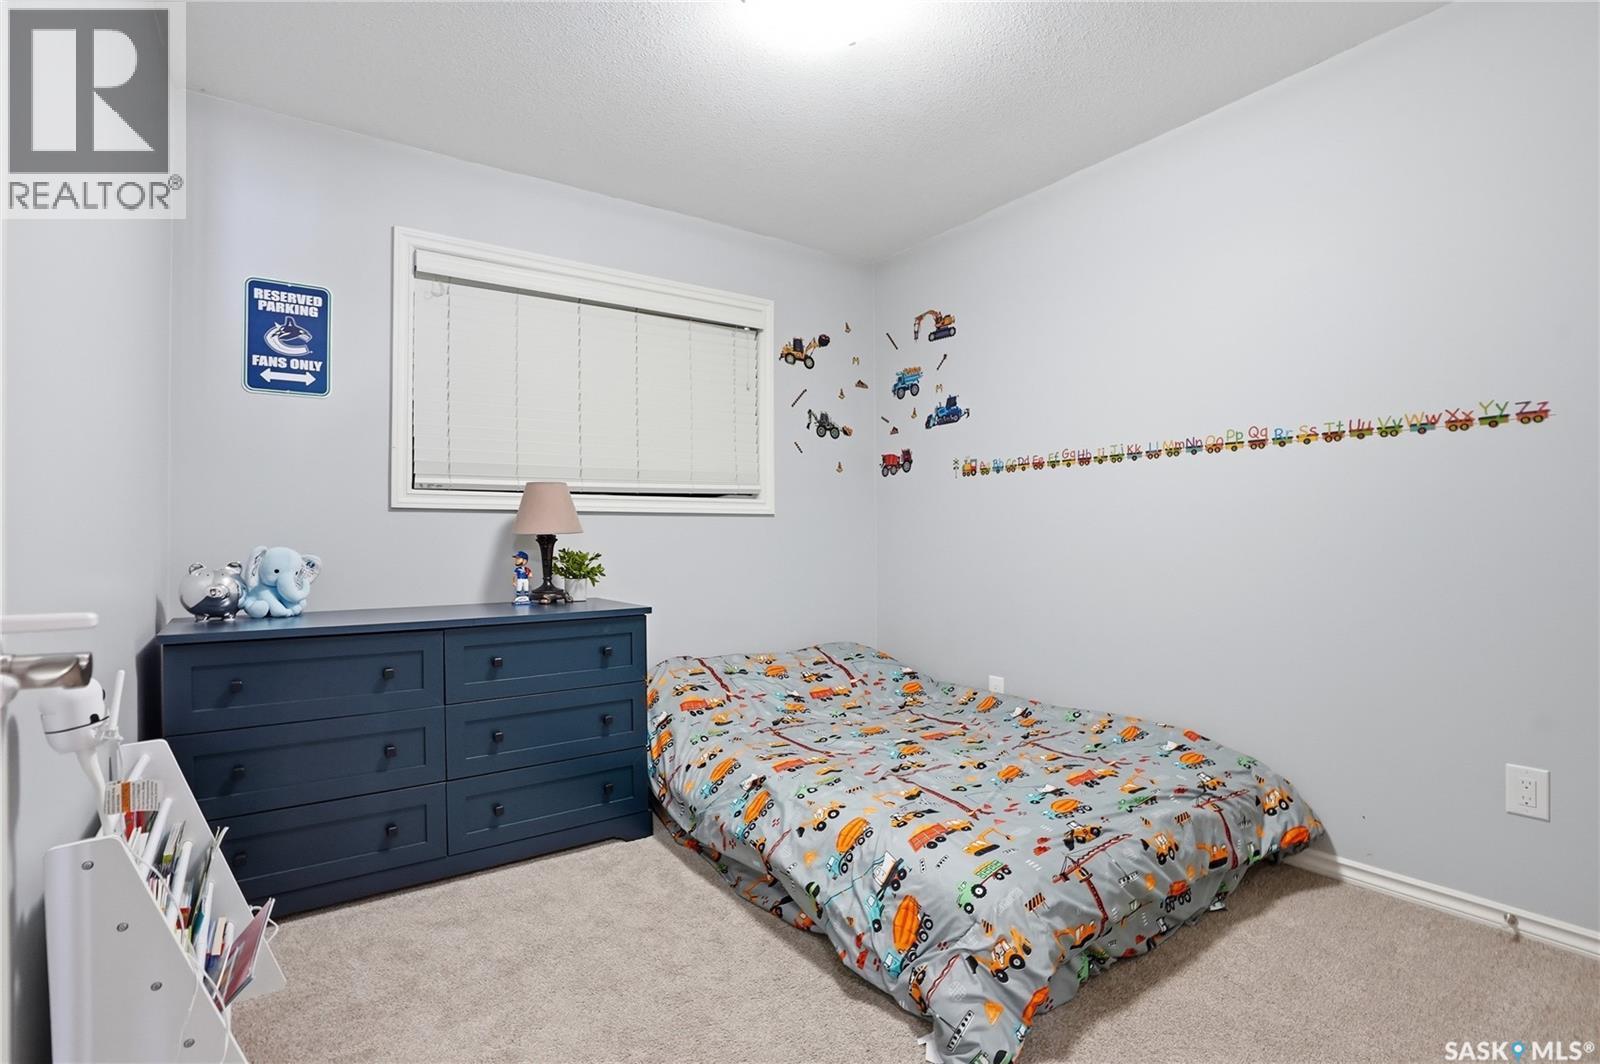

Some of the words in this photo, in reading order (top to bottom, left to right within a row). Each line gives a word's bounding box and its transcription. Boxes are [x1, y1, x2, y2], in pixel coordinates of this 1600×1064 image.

[253, 287, 323, 307] RESERVED
[257, 300, 319, 318] PARKING
[251, 354, 288, 369] FANS
[289, 358, 323, 372] ONLY
[1162, 439, 1186, 450] Mm
[1185, 436, 1203, 448] Nn
[1226, 428, 1244, 442] Pp
[1248, 425, 1268, 441] Qq
[1299, 424, 1318, 436] Ss
[1324, 420, 1345, 434] Tt
[1378, 415, 1403, 429] Vv
[1404, 411, 1443, 426] Ww
[1445, 407, 1474, 421] Xx
